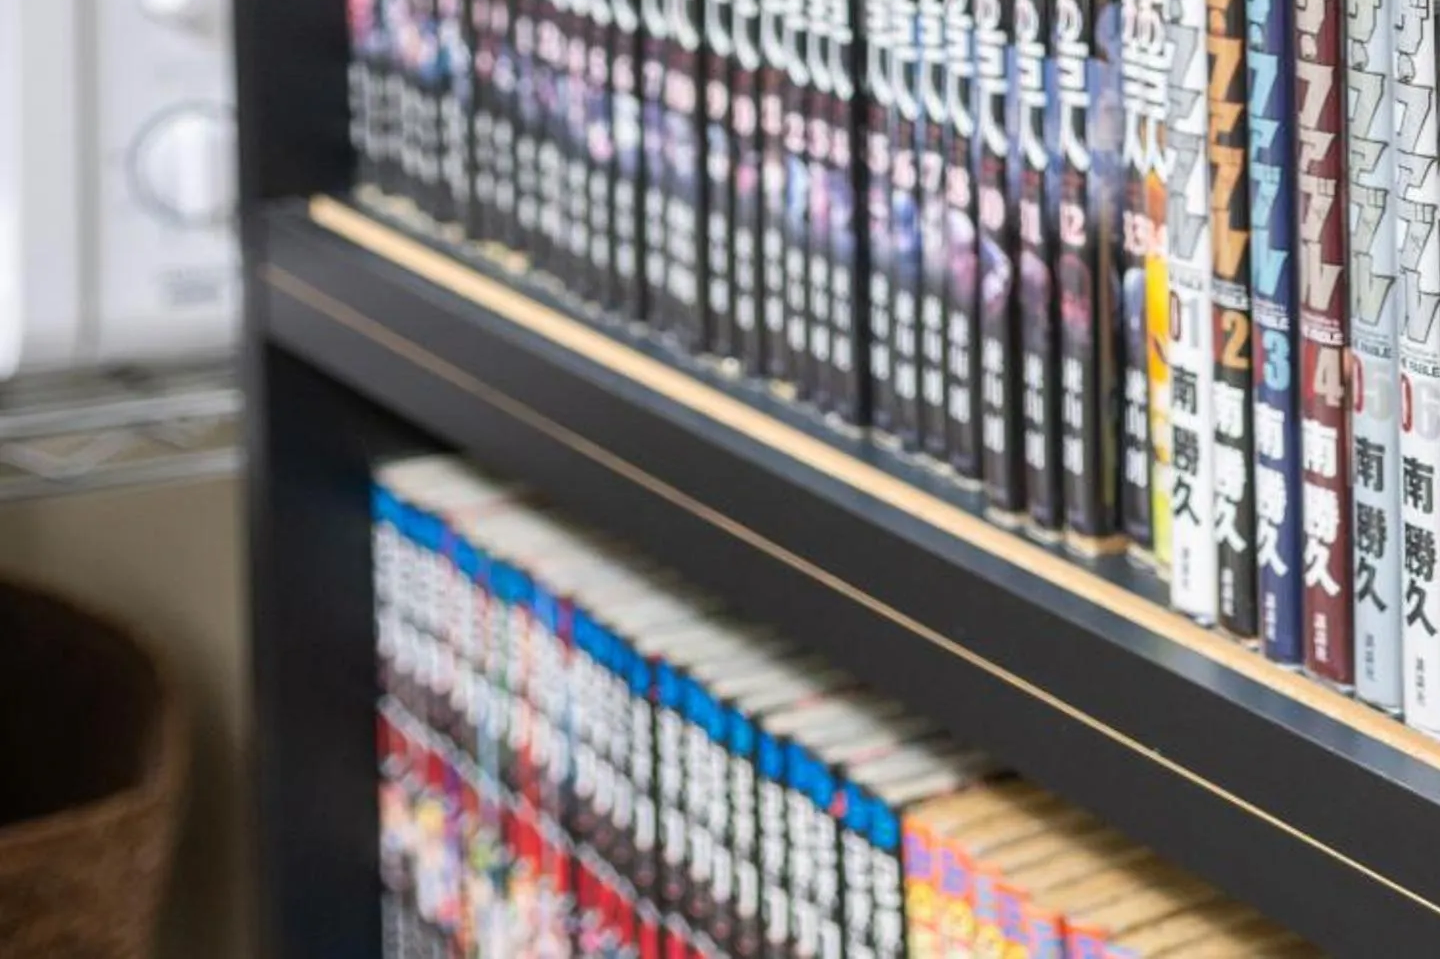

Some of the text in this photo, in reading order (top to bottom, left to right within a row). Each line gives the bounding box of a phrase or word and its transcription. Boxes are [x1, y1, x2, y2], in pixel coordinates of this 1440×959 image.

[1303, 419, 1341, 597] 南勝久
[1355, 436, 1387, 612] 南勝久
[1402, 455, 1437, 637] 南勝久
